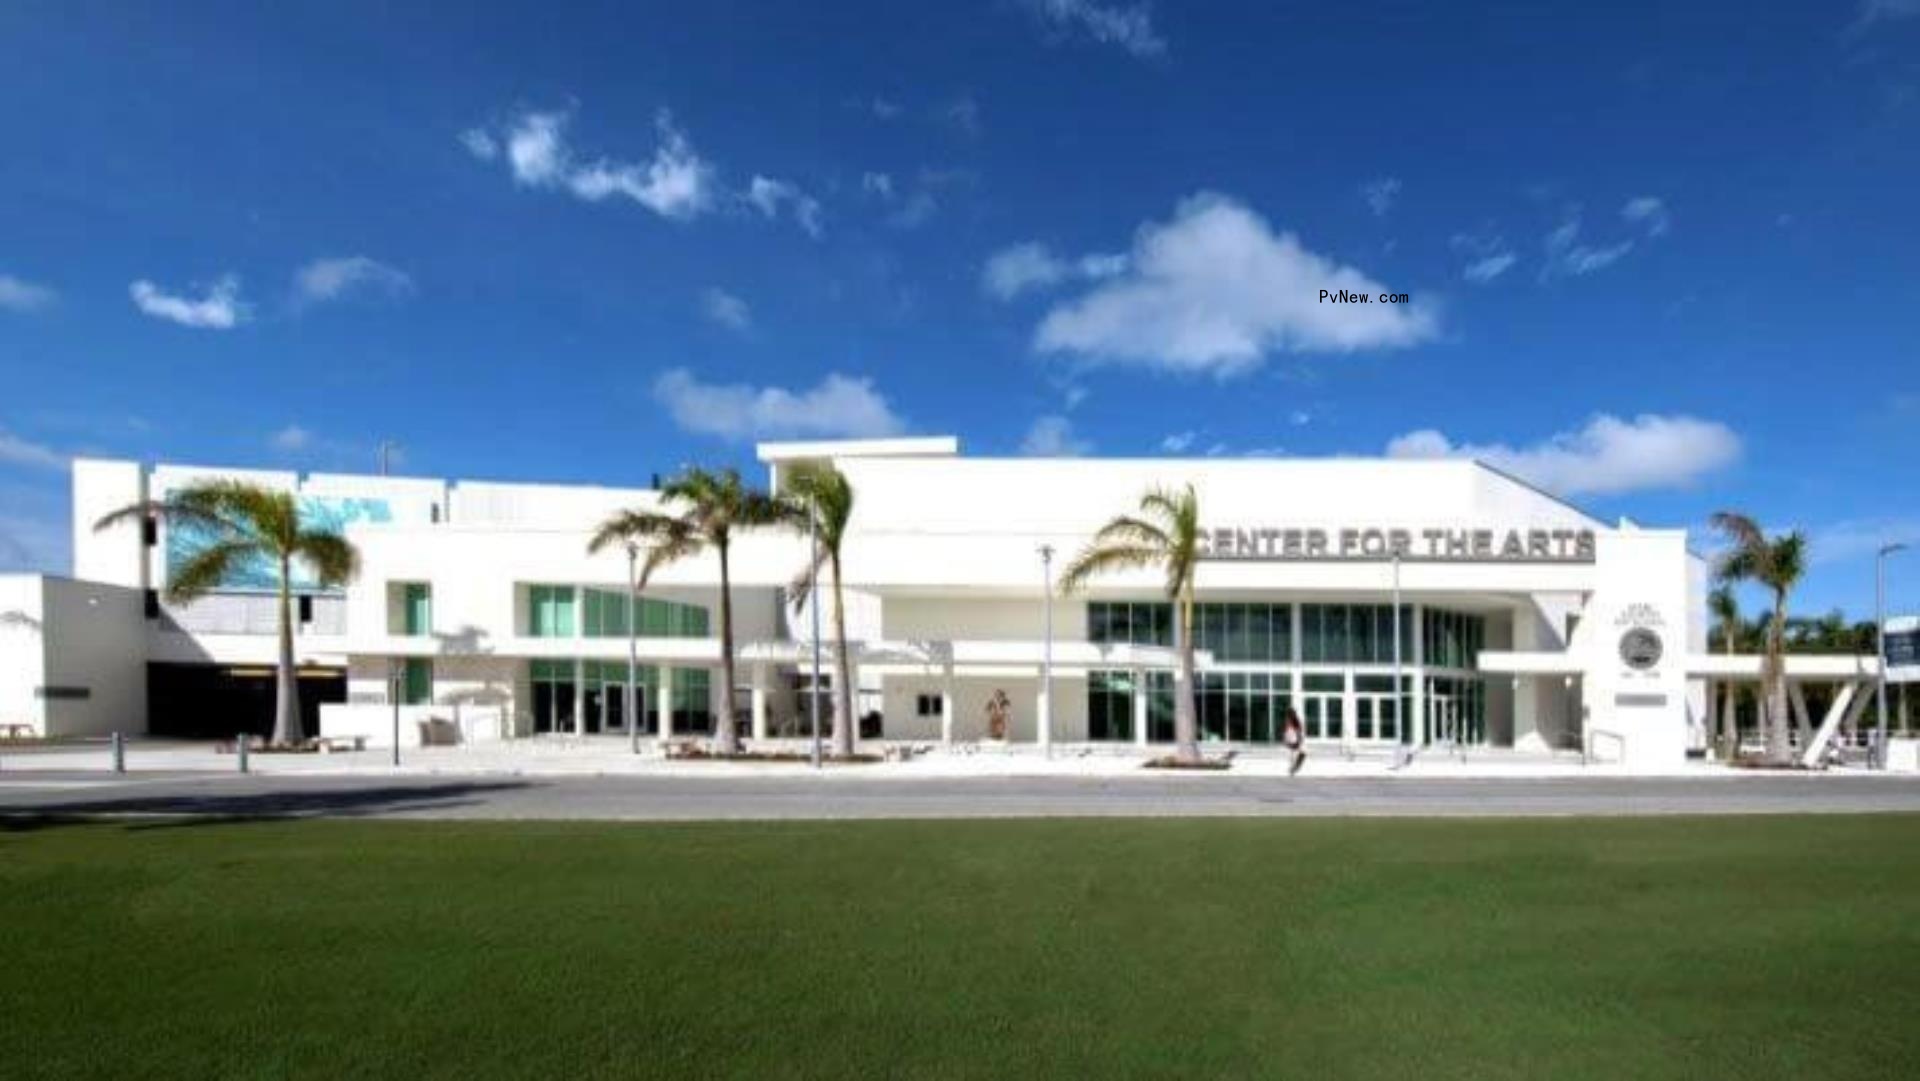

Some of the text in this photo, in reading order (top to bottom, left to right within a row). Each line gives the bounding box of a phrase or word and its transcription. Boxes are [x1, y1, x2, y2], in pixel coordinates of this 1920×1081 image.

[1339, 528, 1412, 558] FOR
[1422, 528, 1494, 559] THE
[1502, 528, 1596, 560] ARTS
